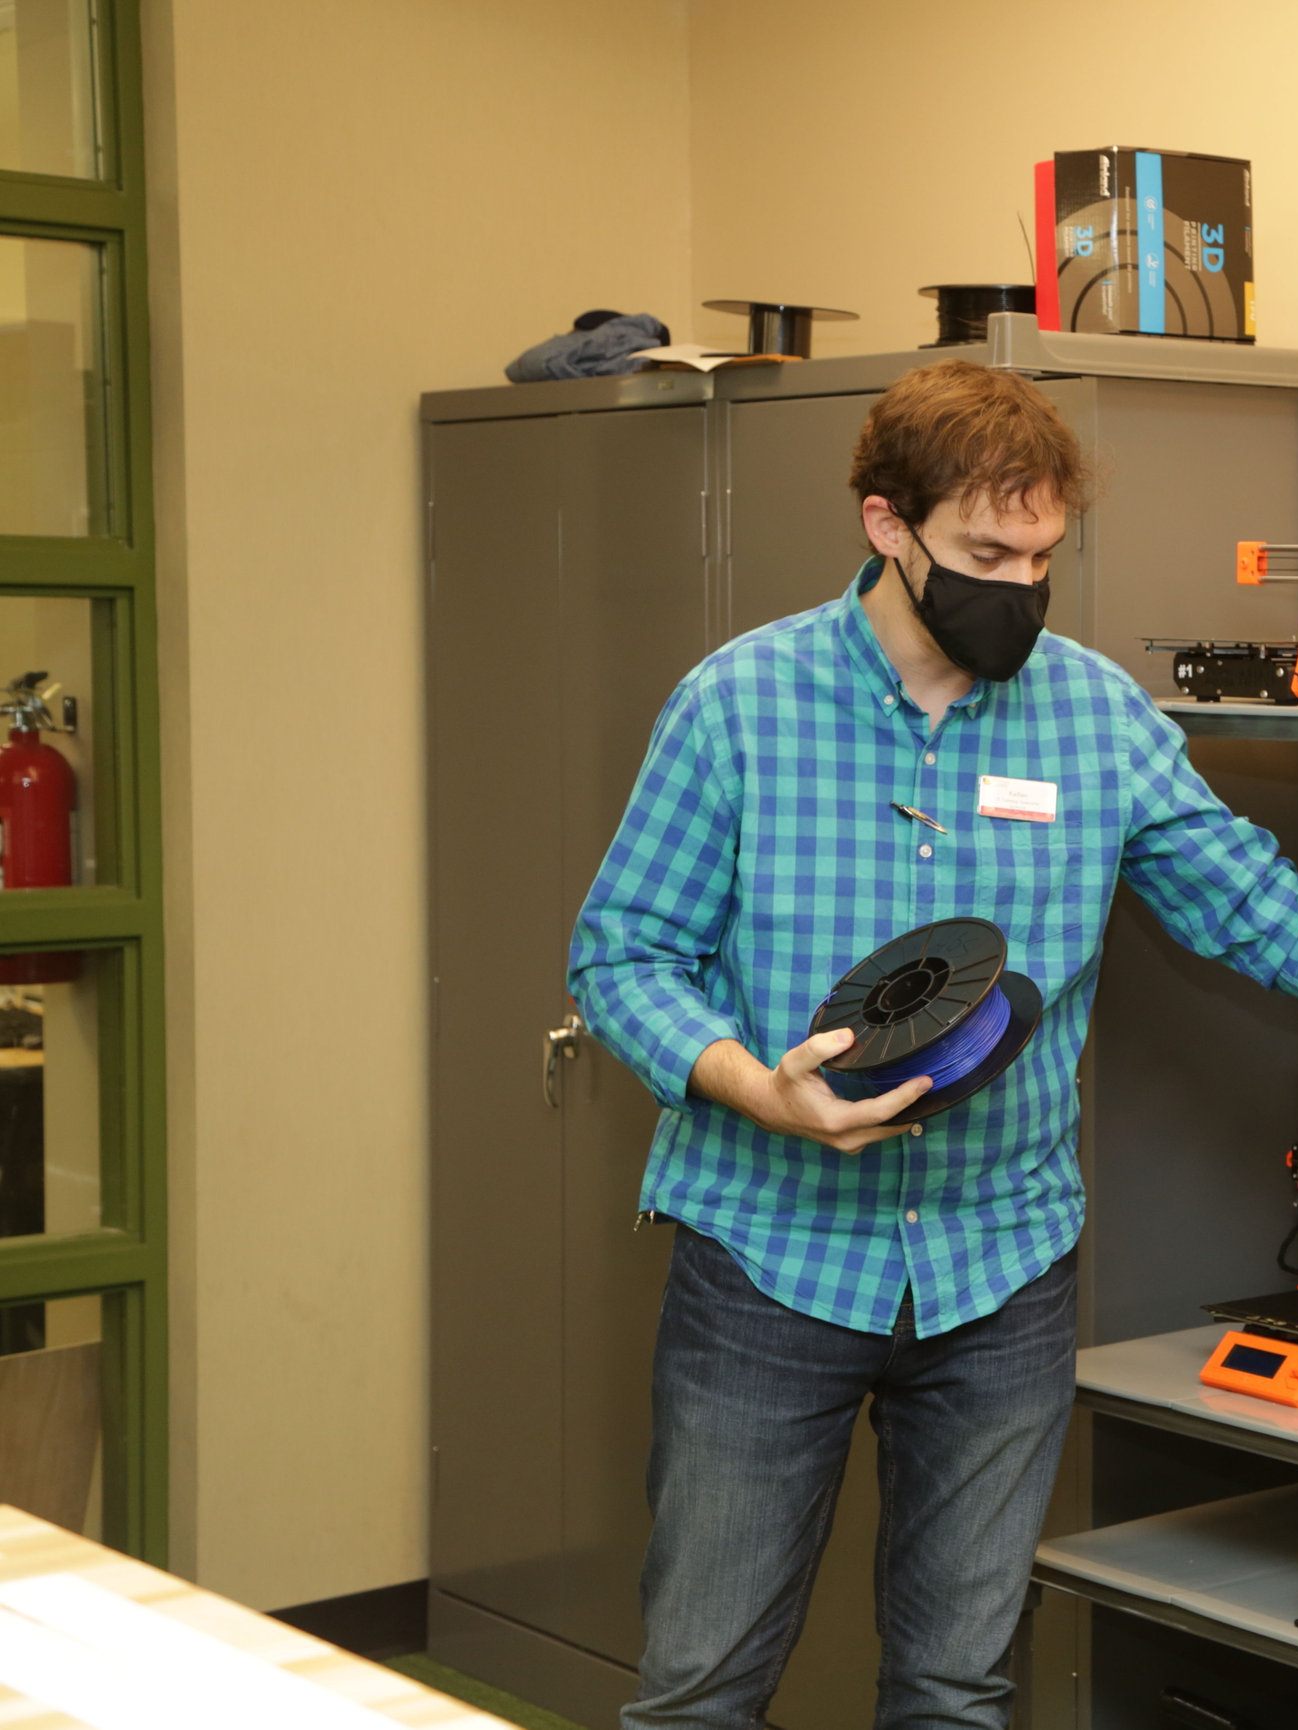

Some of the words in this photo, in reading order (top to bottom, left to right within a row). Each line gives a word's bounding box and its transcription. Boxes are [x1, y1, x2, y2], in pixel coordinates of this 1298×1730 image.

[1076, 225, 1094, 257] 3D
[1183, 220, 1191, 270] FILAMENT
[1190, 221, 1198, 271] PRINTING
[1201, 223, 1225, 273] 3D
[1178, 663, 1193, 679] #1
